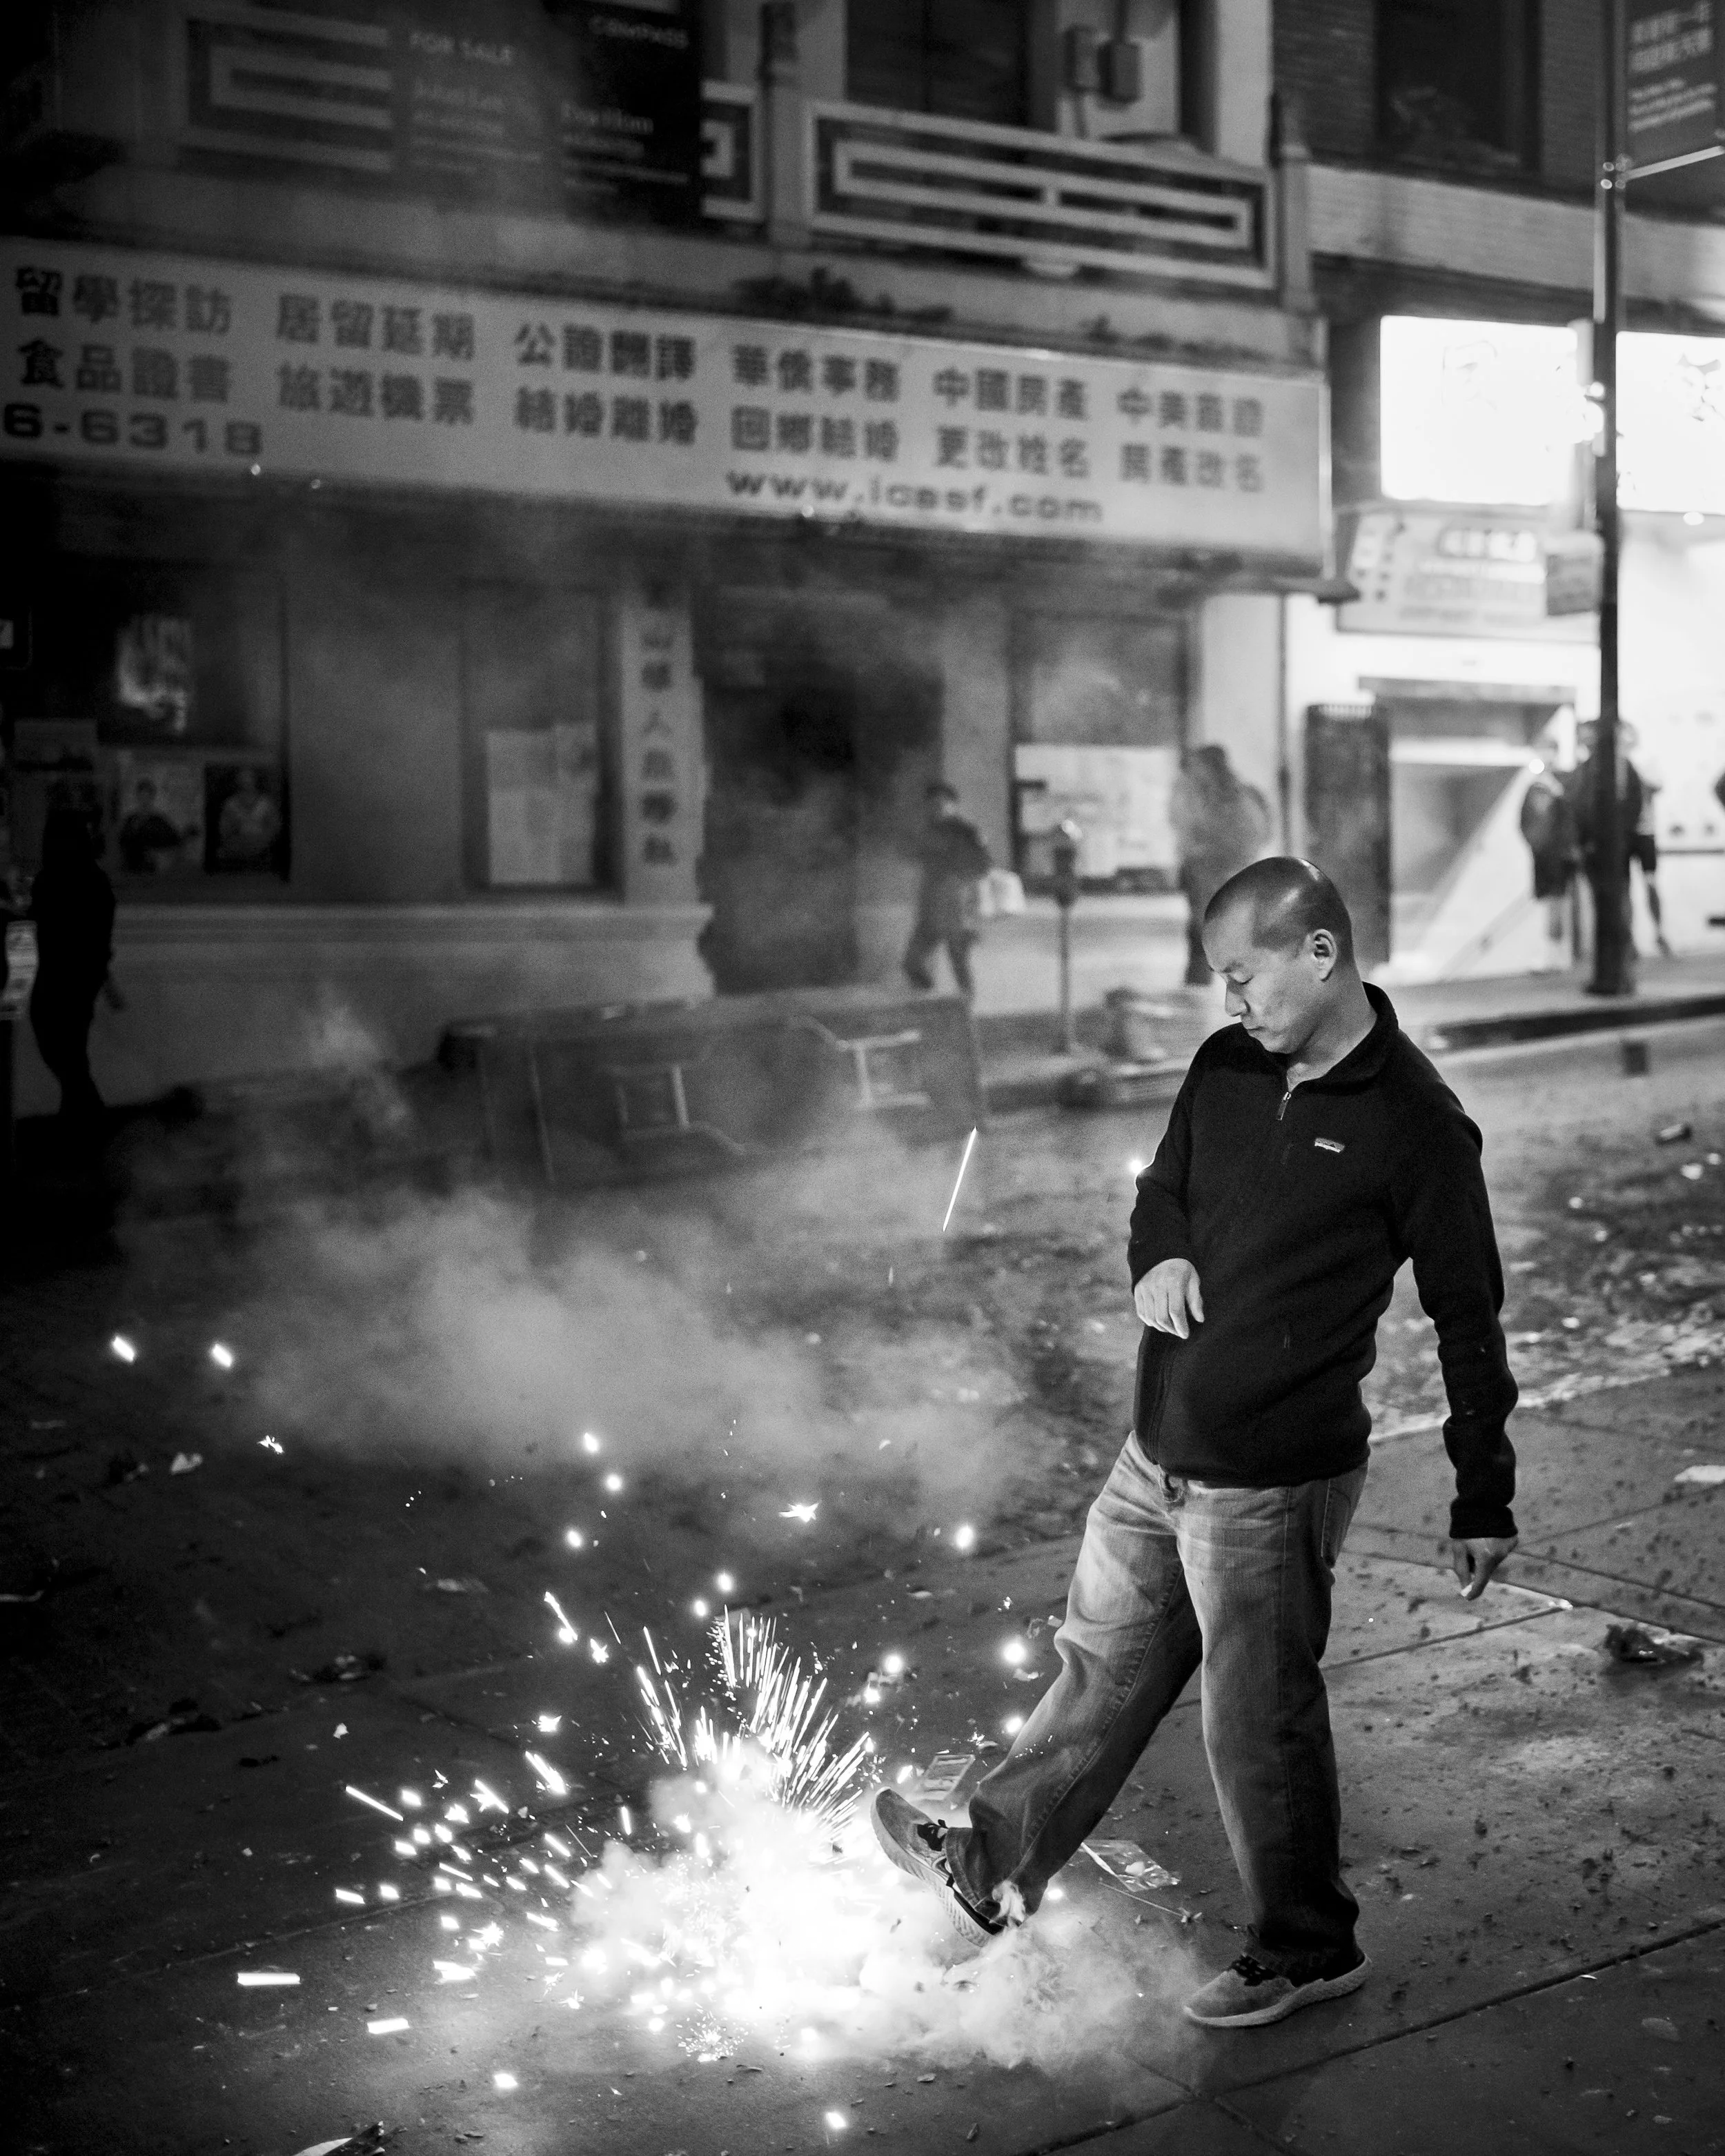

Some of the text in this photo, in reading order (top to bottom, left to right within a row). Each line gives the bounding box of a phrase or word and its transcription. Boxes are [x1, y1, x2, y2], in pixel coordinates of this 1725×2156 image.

[409, 30, 515, 66] FOR SALE
[15, 265, 233, 335] 留學探訪
[17, 339, 232, 405] 食品證書
[3, 402, 263, 457] 6-6318
